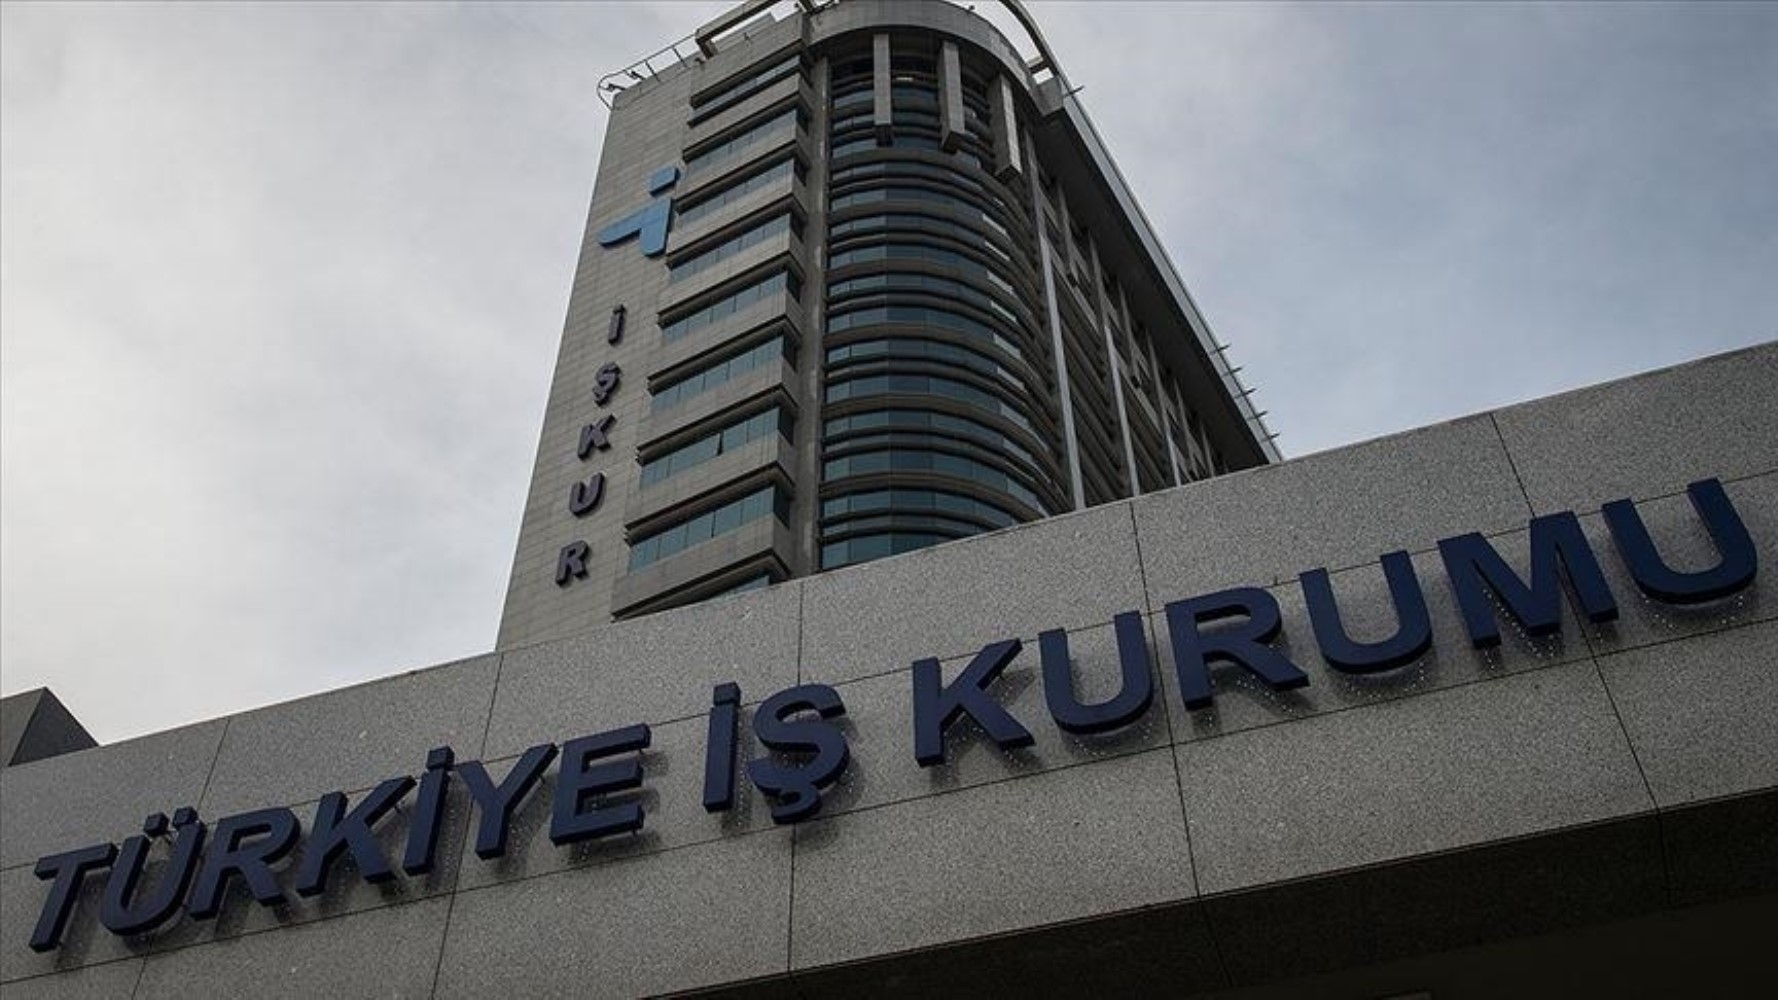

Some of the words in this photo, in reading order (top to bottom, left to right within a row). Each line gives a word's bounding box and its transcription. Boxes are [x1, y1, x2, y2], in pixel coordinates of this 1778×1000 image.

[557, 304, 625, 586] İŞKUR
[29, 723, 650, 952] TÜRKİYE
[703, 682, 850, 825] İŞ
[913, 478, 1758, 767] KURUMU
